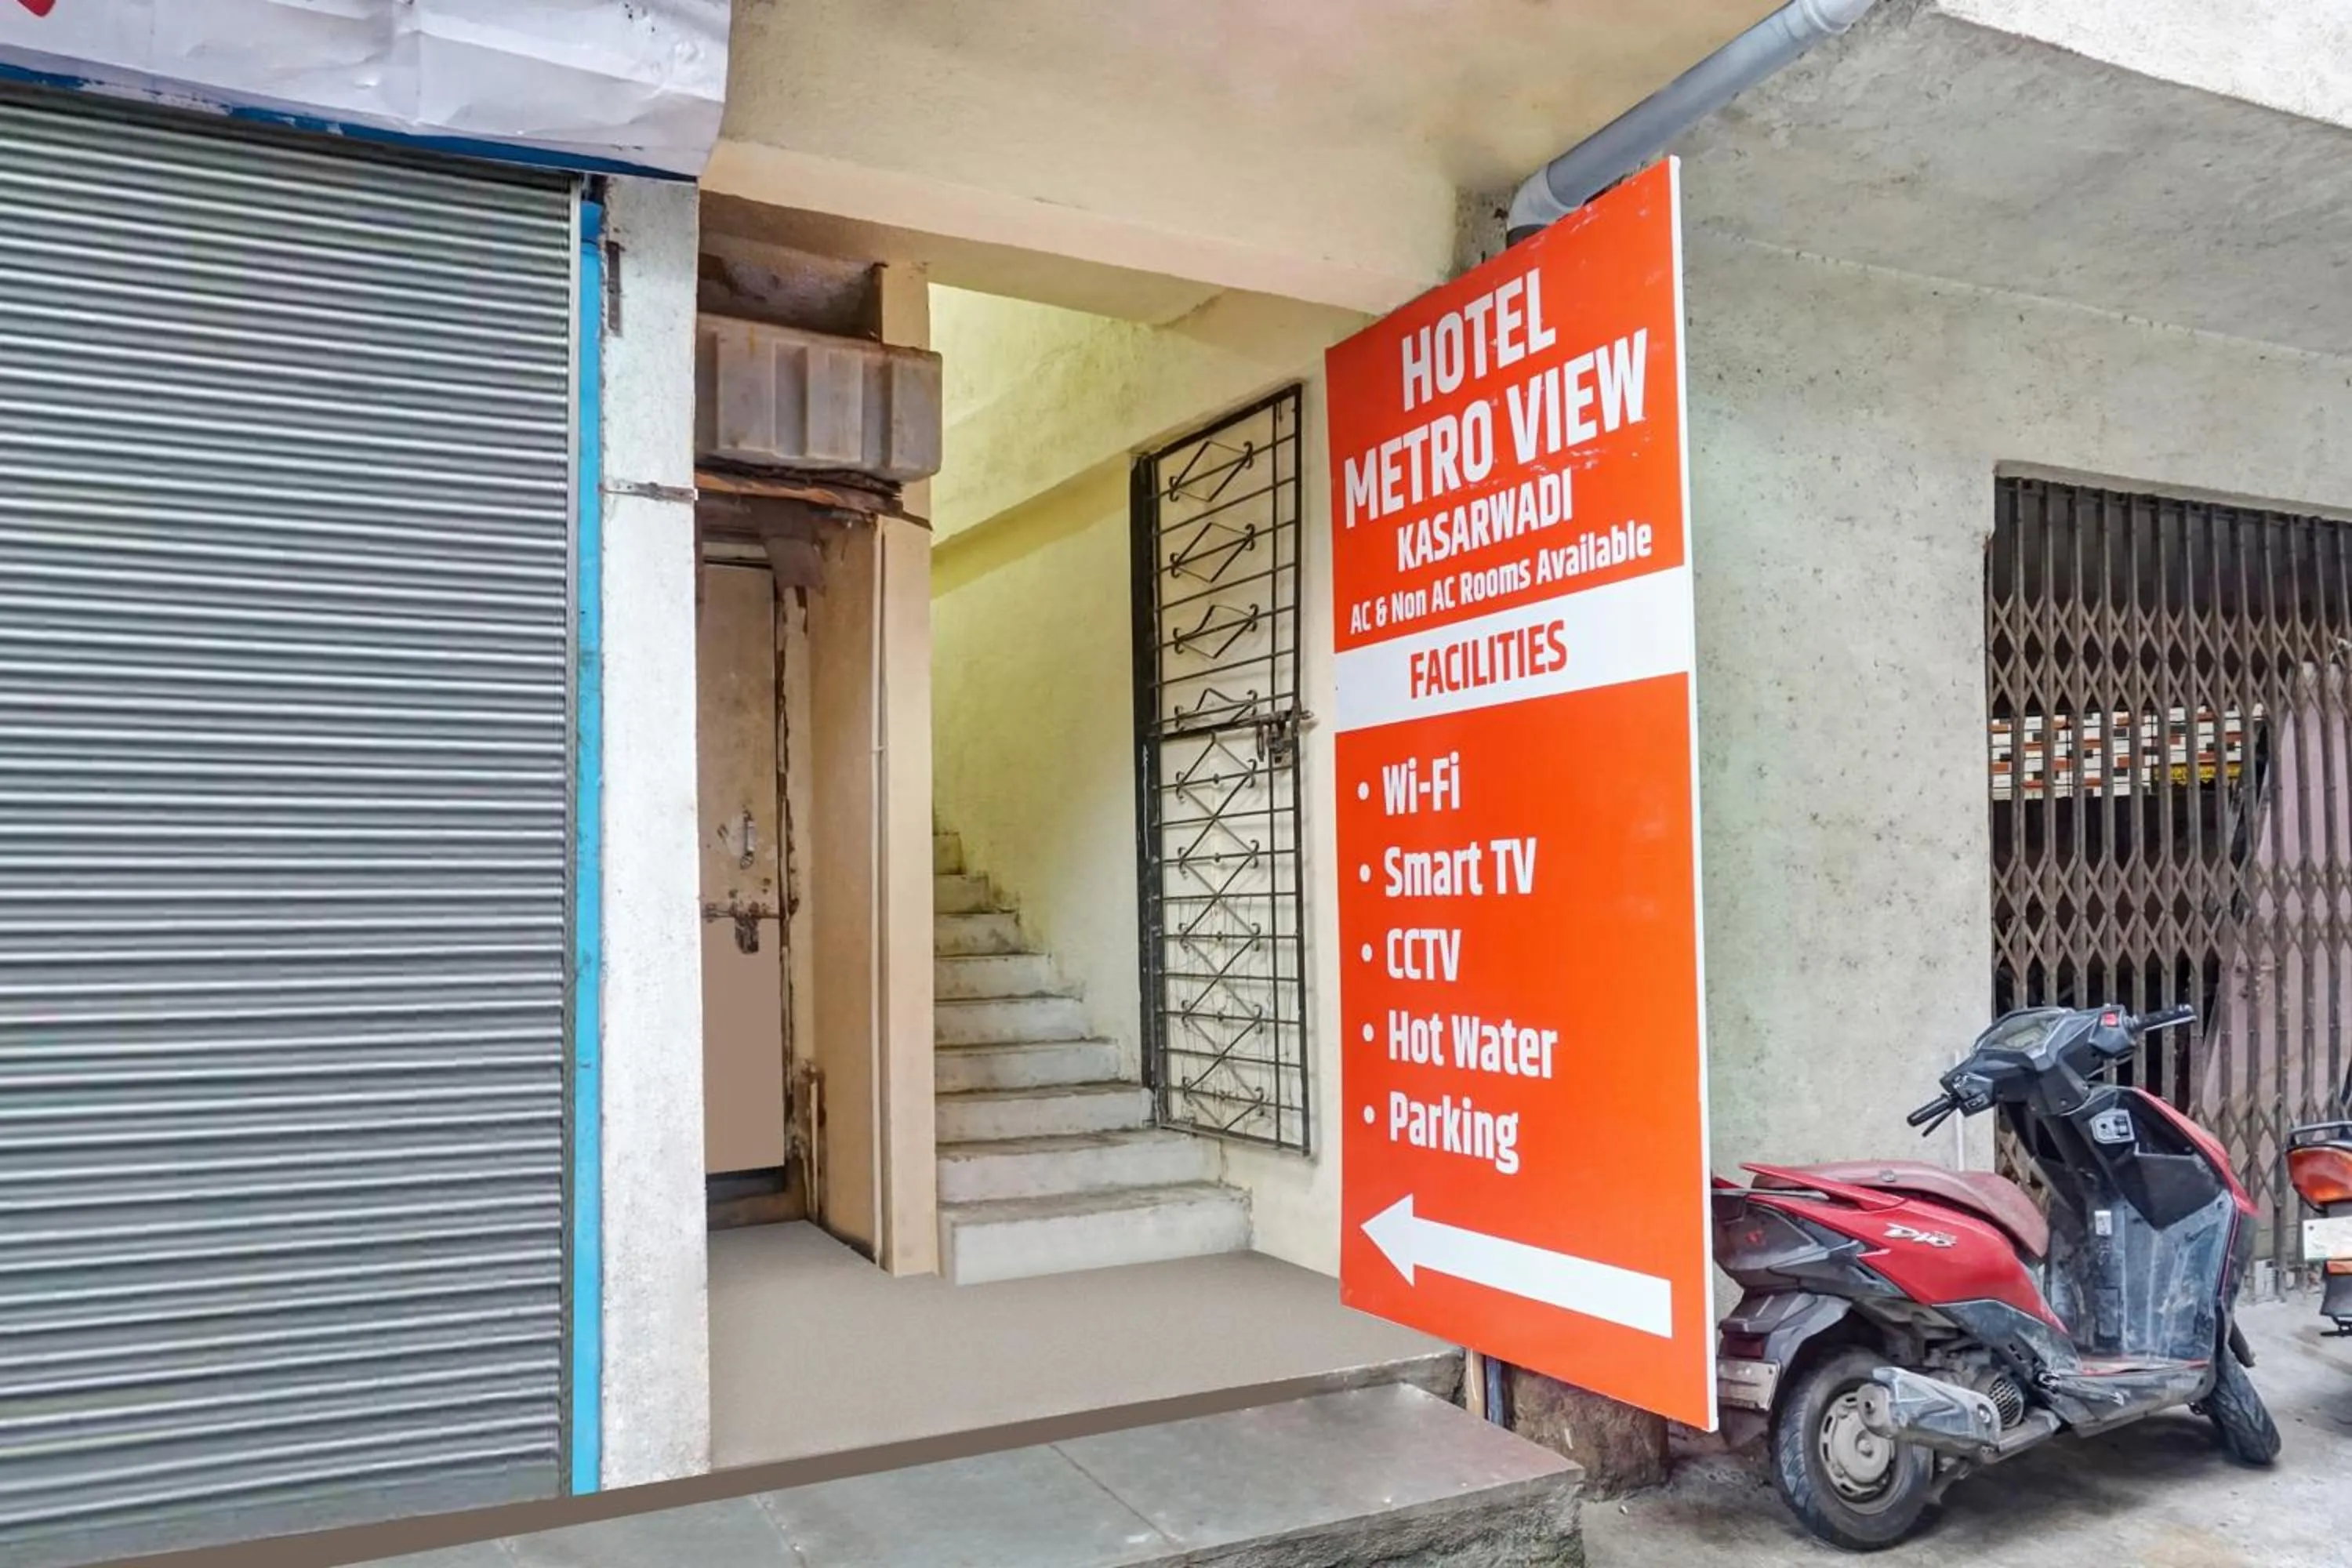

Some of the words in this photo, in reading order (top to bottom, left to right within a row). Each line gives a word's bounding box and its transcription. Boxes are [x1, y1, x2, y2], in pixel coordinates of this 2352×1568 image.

[1402, 267, 1556, 412] HOTEL
[1344, 398, 1493, 528] METRO
[1506, 328, 1647, 466] VIEW
[1397, 468, 1573, 572] KASARWADI
[1350, 602, 1372, 635] AC
[1375, 598, 1387, 628] &
[1391, 589, 1427, 622] Non
[1432, 577, 1456, 612] AC
[1460, 559, 1531, 606] Rooms
[1537, 521, 1652, 584] Available
[1410, 619, 1567, 699] FACILITIES
[1382, 751, 1461, 815] Wi-Fi
[1385, 841, 1483, 897] Smart
[1490, 837, 1537, 895] TV
[1387, 927, 1461, 982] CCTV
[1388, 1010, 1444, 1066] Hot
[1451, 1014, 1558, 1079] Water
[1389, 1091, 1519, 1174] Parking
